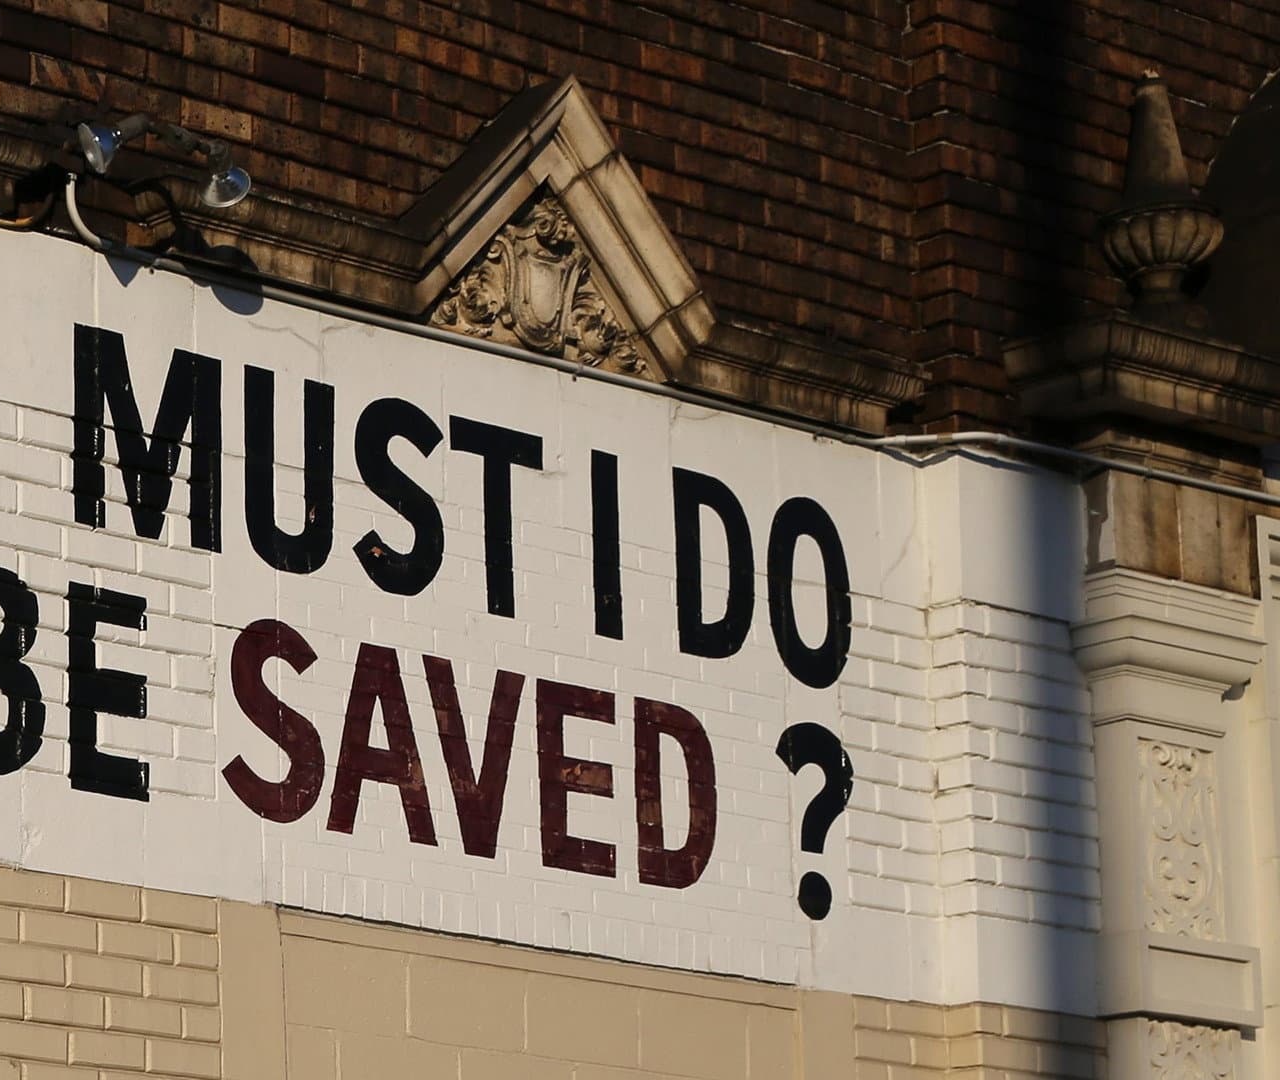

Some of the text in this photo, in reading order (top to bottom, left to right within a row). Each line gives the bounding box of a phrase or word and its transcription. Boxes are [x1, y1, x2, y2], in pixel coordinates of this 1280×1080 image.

[72, 322, 544, 620] MUST
[591, 449, 624, 640] I
[673, 466, 852, 690] DO
[221, 618, 718, 890] SAVED
[774, 722, 854, 922] ?
